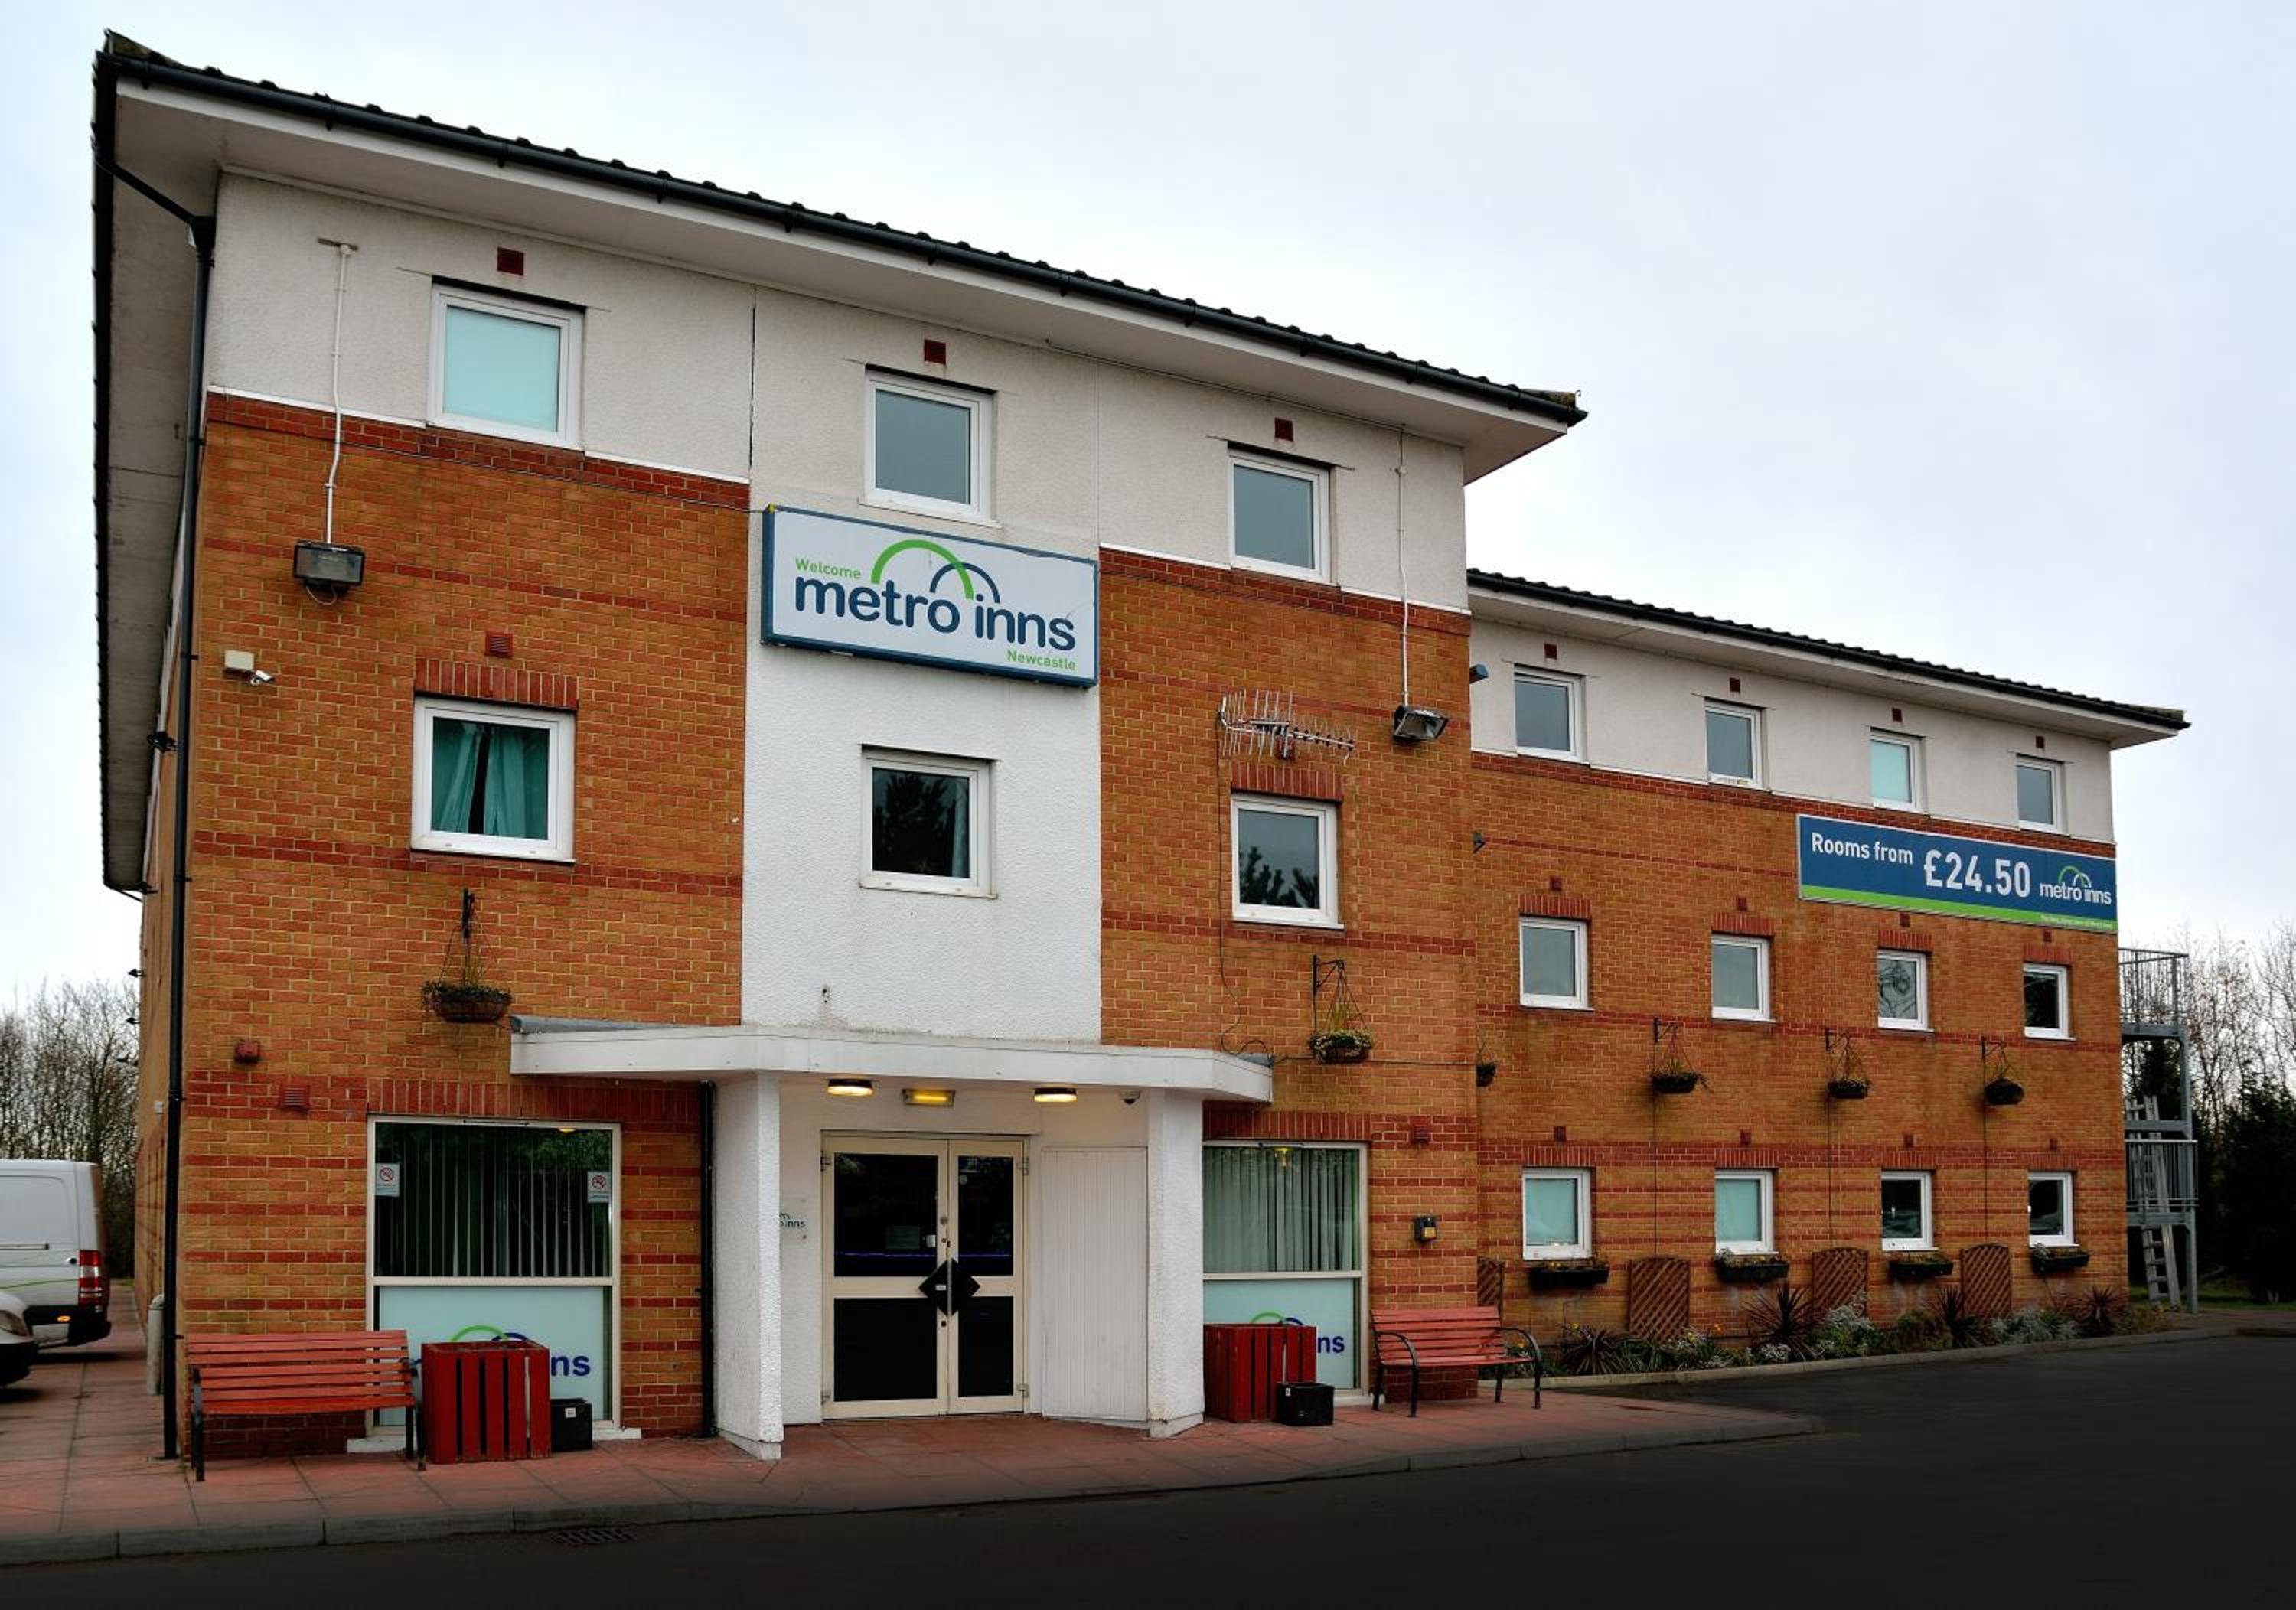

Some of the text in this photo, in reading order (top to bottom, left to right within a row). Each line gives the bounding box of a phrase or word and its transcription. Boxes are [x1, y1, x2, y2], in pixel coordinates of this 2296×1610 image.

[795, 557, 861, 579] Welcome
[795, 576, 1076, 651] metro inns
[1007, 650, 1077, 670] Newcastle
[1812, 832, 2030, 898] Rooms from £24.50
[2040, 881, 2112, 905] metro inns
